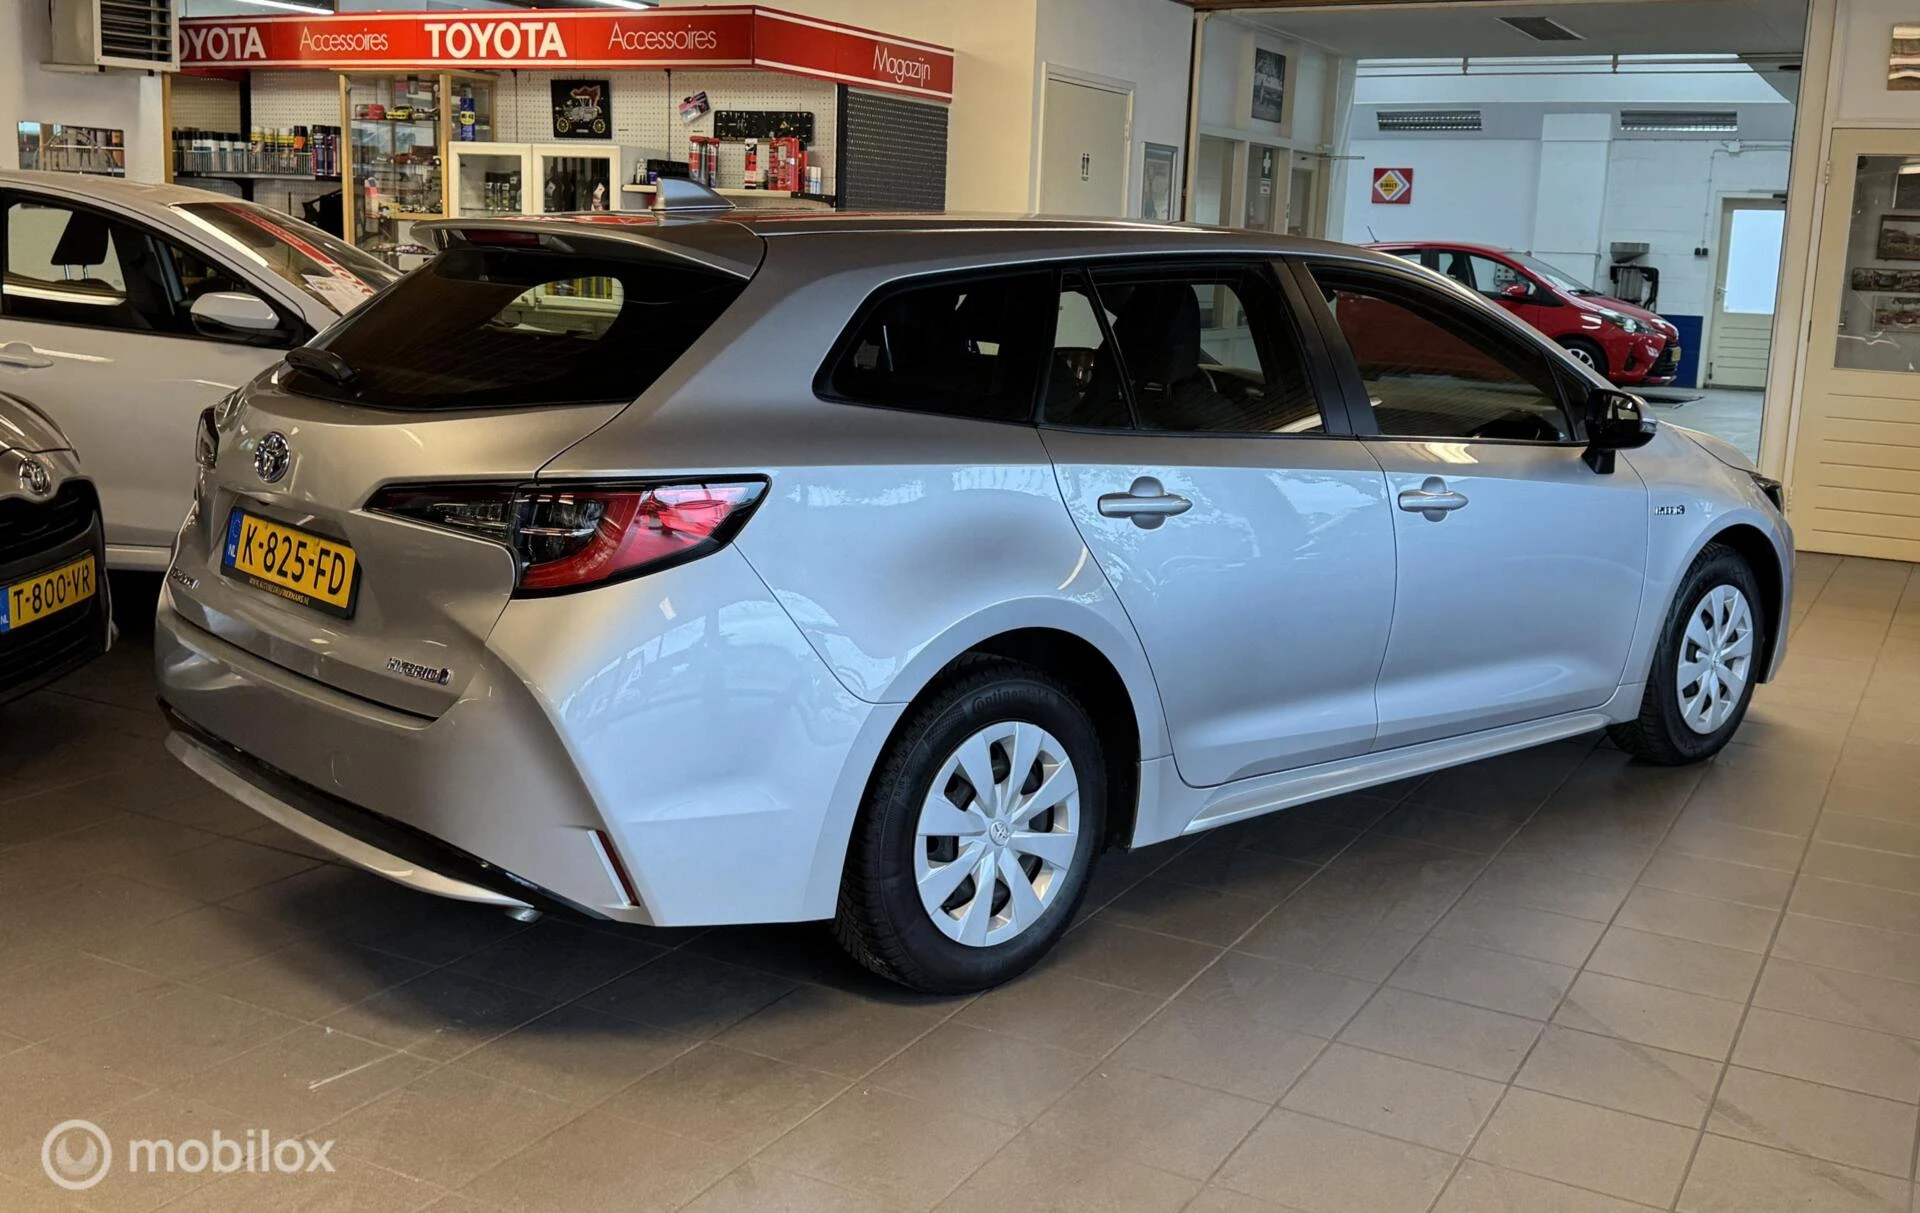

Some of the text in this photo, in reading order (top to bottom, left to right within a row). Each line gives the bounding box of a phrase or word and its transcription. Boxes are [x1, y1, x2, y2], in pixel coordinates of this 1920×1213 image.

[179, 21, 717, 60] YOTA Accessoires TOYOTA Accessoires
[872, 45, 931, 88] Magazijn
[228, 543, 236, 558] NL
[242, 523, 346, 596] K-825-FD
[13, 564, 92, 621] T-800-VR
[387, 656, 440, 682] HYBRID
